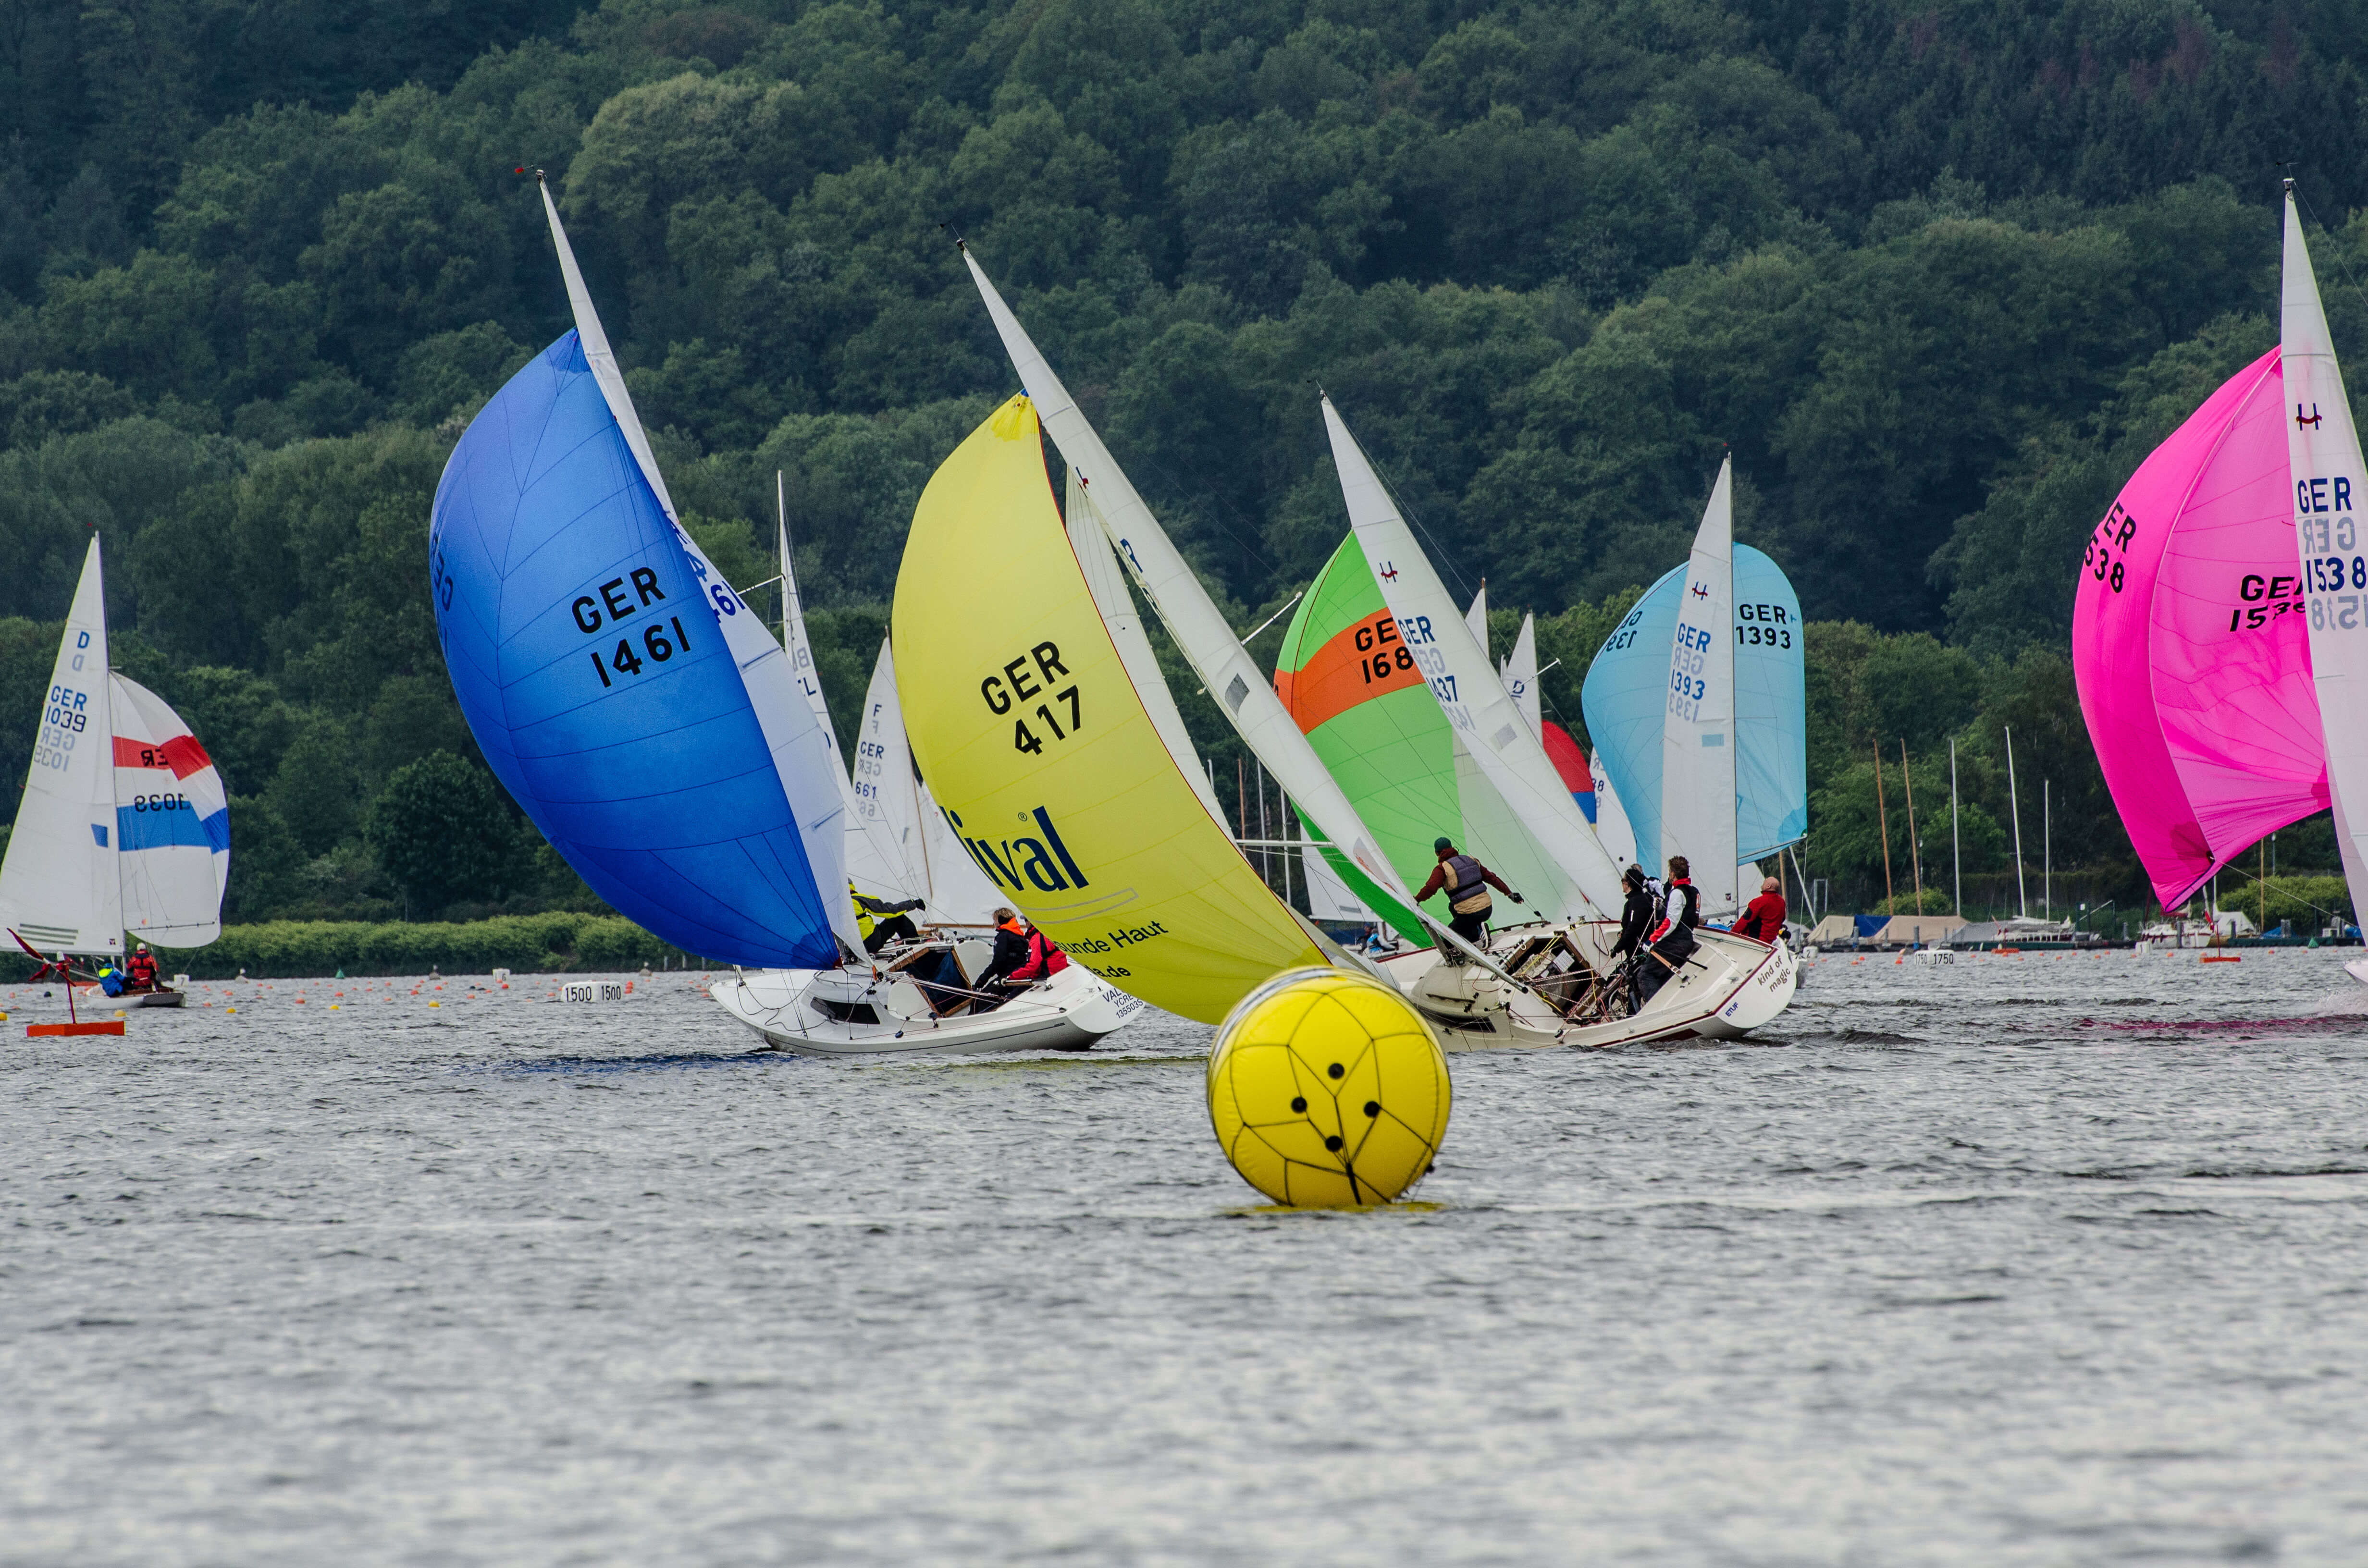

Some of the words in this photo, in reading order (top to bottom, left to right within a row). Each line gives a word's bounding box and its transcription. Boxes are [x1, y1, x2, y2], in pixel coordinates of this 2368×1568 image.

[2298, 477, 2352, 514] GER
[2306, 556, 2367, 593] 1538
[572, 566, 666, 634] GER
[1739, 604, 1787, 625] GER
[77, 631, 90, 649] D
[1398, 616, 1436, 644] GER
[1677, 623, 1711, 653] GER
[1736, 626, 1791, 649] 1393
[590, 616, 691, 687] 1461
[982, 641, 1070, 715] GER
[1513, 680, 1525, 694] D
[1671, 669, 1705, 700] 1393
[51, 686, 87, 711] GER
[873, 704, 882, 717] F
[45, 705, 86, 733] 1039
[1015, 685, 1081, 756] 417
[860, 741, 884, 759] GER
[856, 782, 876, 799] 661
[1108, 921, 1169, 948] Haut
[1757, 966, 1775, 985] kind
[1775, 956, 1783, 968] of
[1934, 953, 1954, 964] 1750
[1769, 968, 1790, 992] magic
[566, 986, 592, 1002] 1500
[602, 985, 621, 1000] 1500
[1726, 1002, 1739, 1017] ETUF
